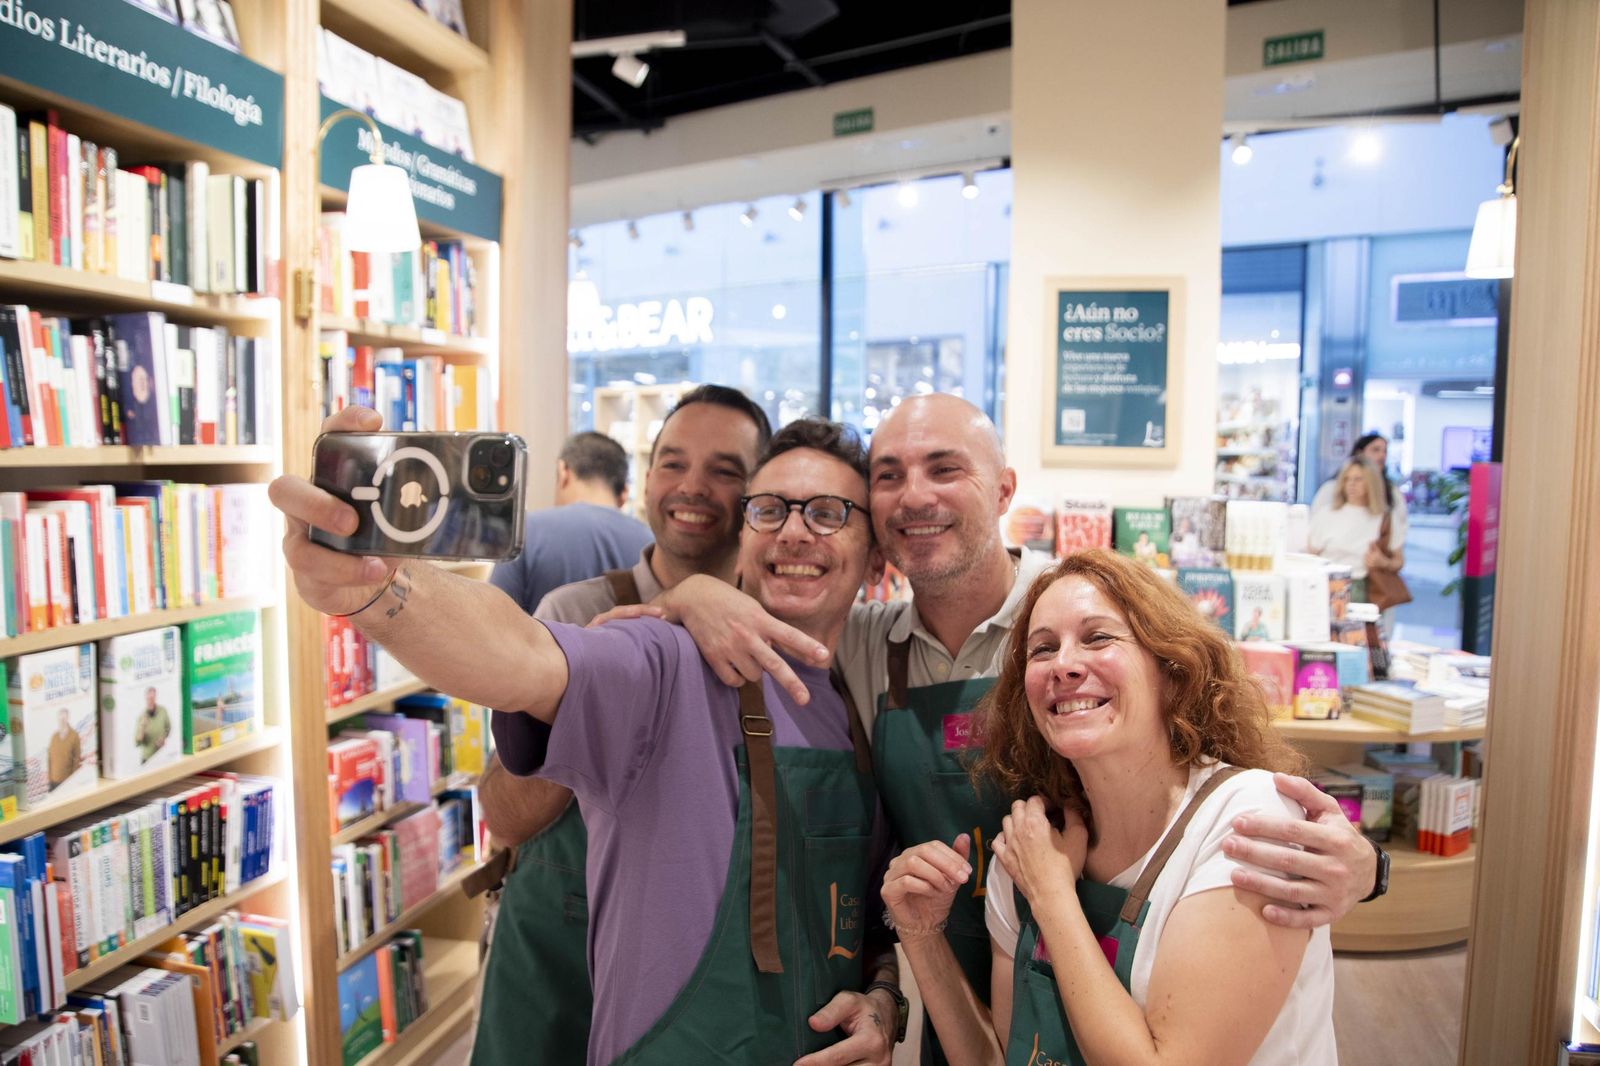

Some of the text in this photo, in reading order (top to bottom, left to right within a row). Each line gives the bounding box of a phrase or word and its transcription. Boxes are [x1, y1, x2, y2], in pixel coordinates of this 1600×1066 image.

[59, 17, 171, 89] Literarios
[183, 69, 263, 126] Filología
[1063, 303, 1139, 323] ¿Aún no
[1063, 322, 1166, 343] eres Socio?
[954, 726, 970, 737] Jos
